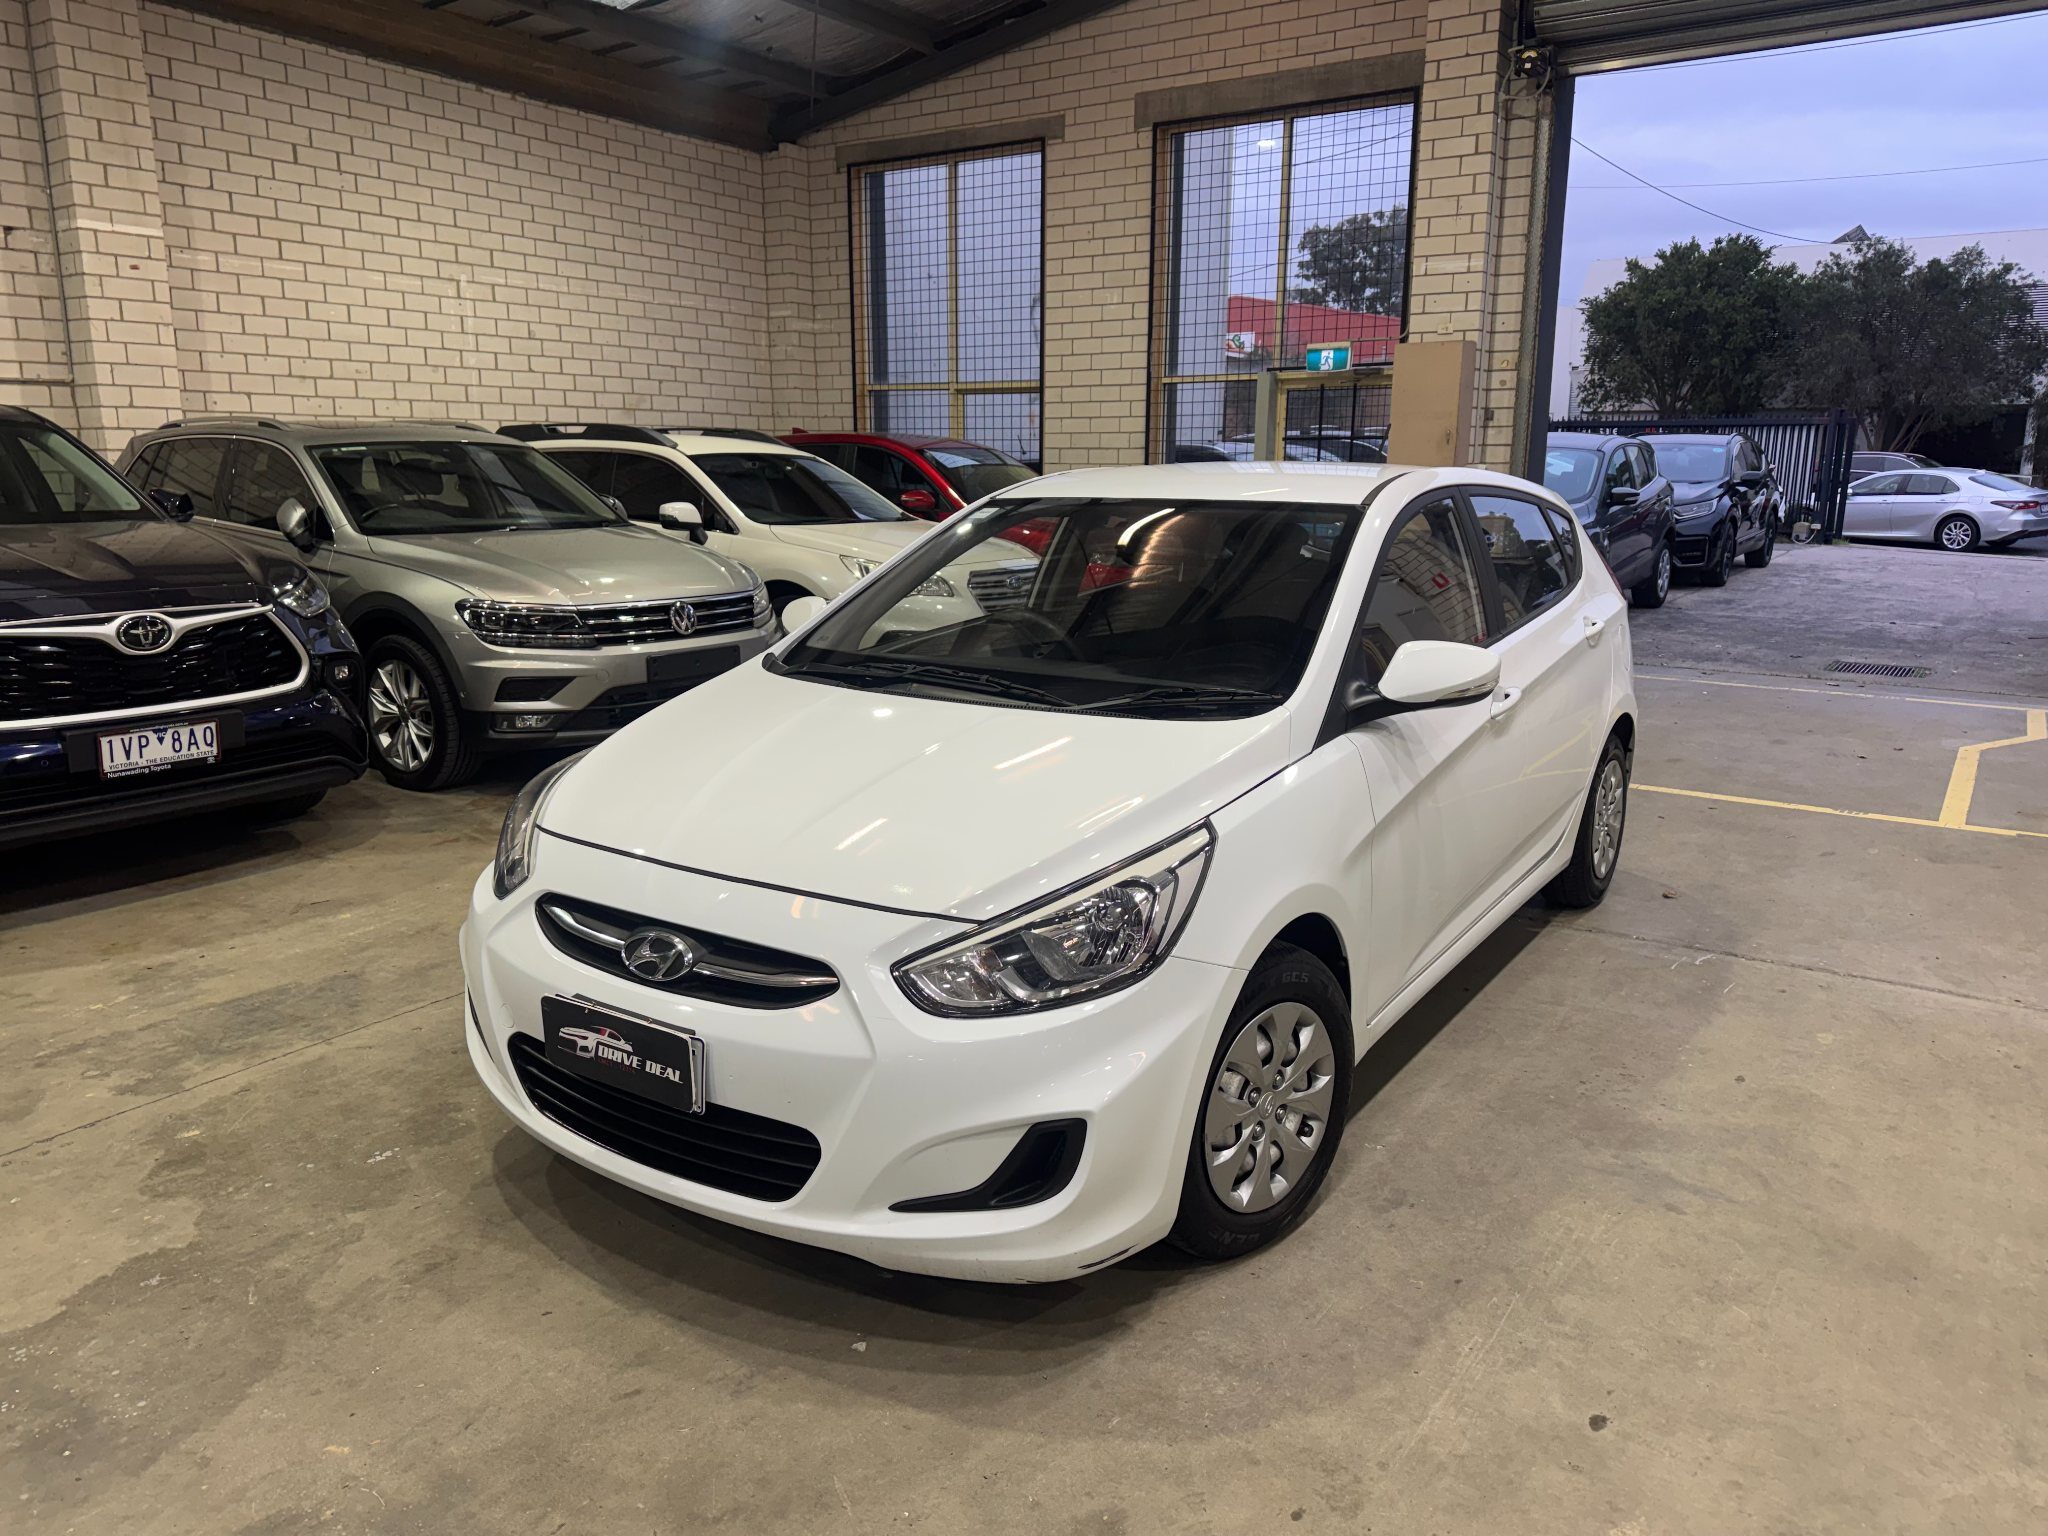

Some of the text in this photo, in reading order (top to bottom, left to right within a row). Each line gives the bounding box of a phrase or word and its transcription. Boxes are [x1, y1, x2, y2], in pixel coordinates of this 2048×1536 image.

[107, 725, 214, 763] 1VP 8AQ
[107, 763, 172, 779] Nunawading Toyota
[108, 749, 214, 770] VICTORIA THE EDUCATION STATE
[598, 1044, 643, 1070] DRIVE
[645, 1059, 684, 1084] DEAL
